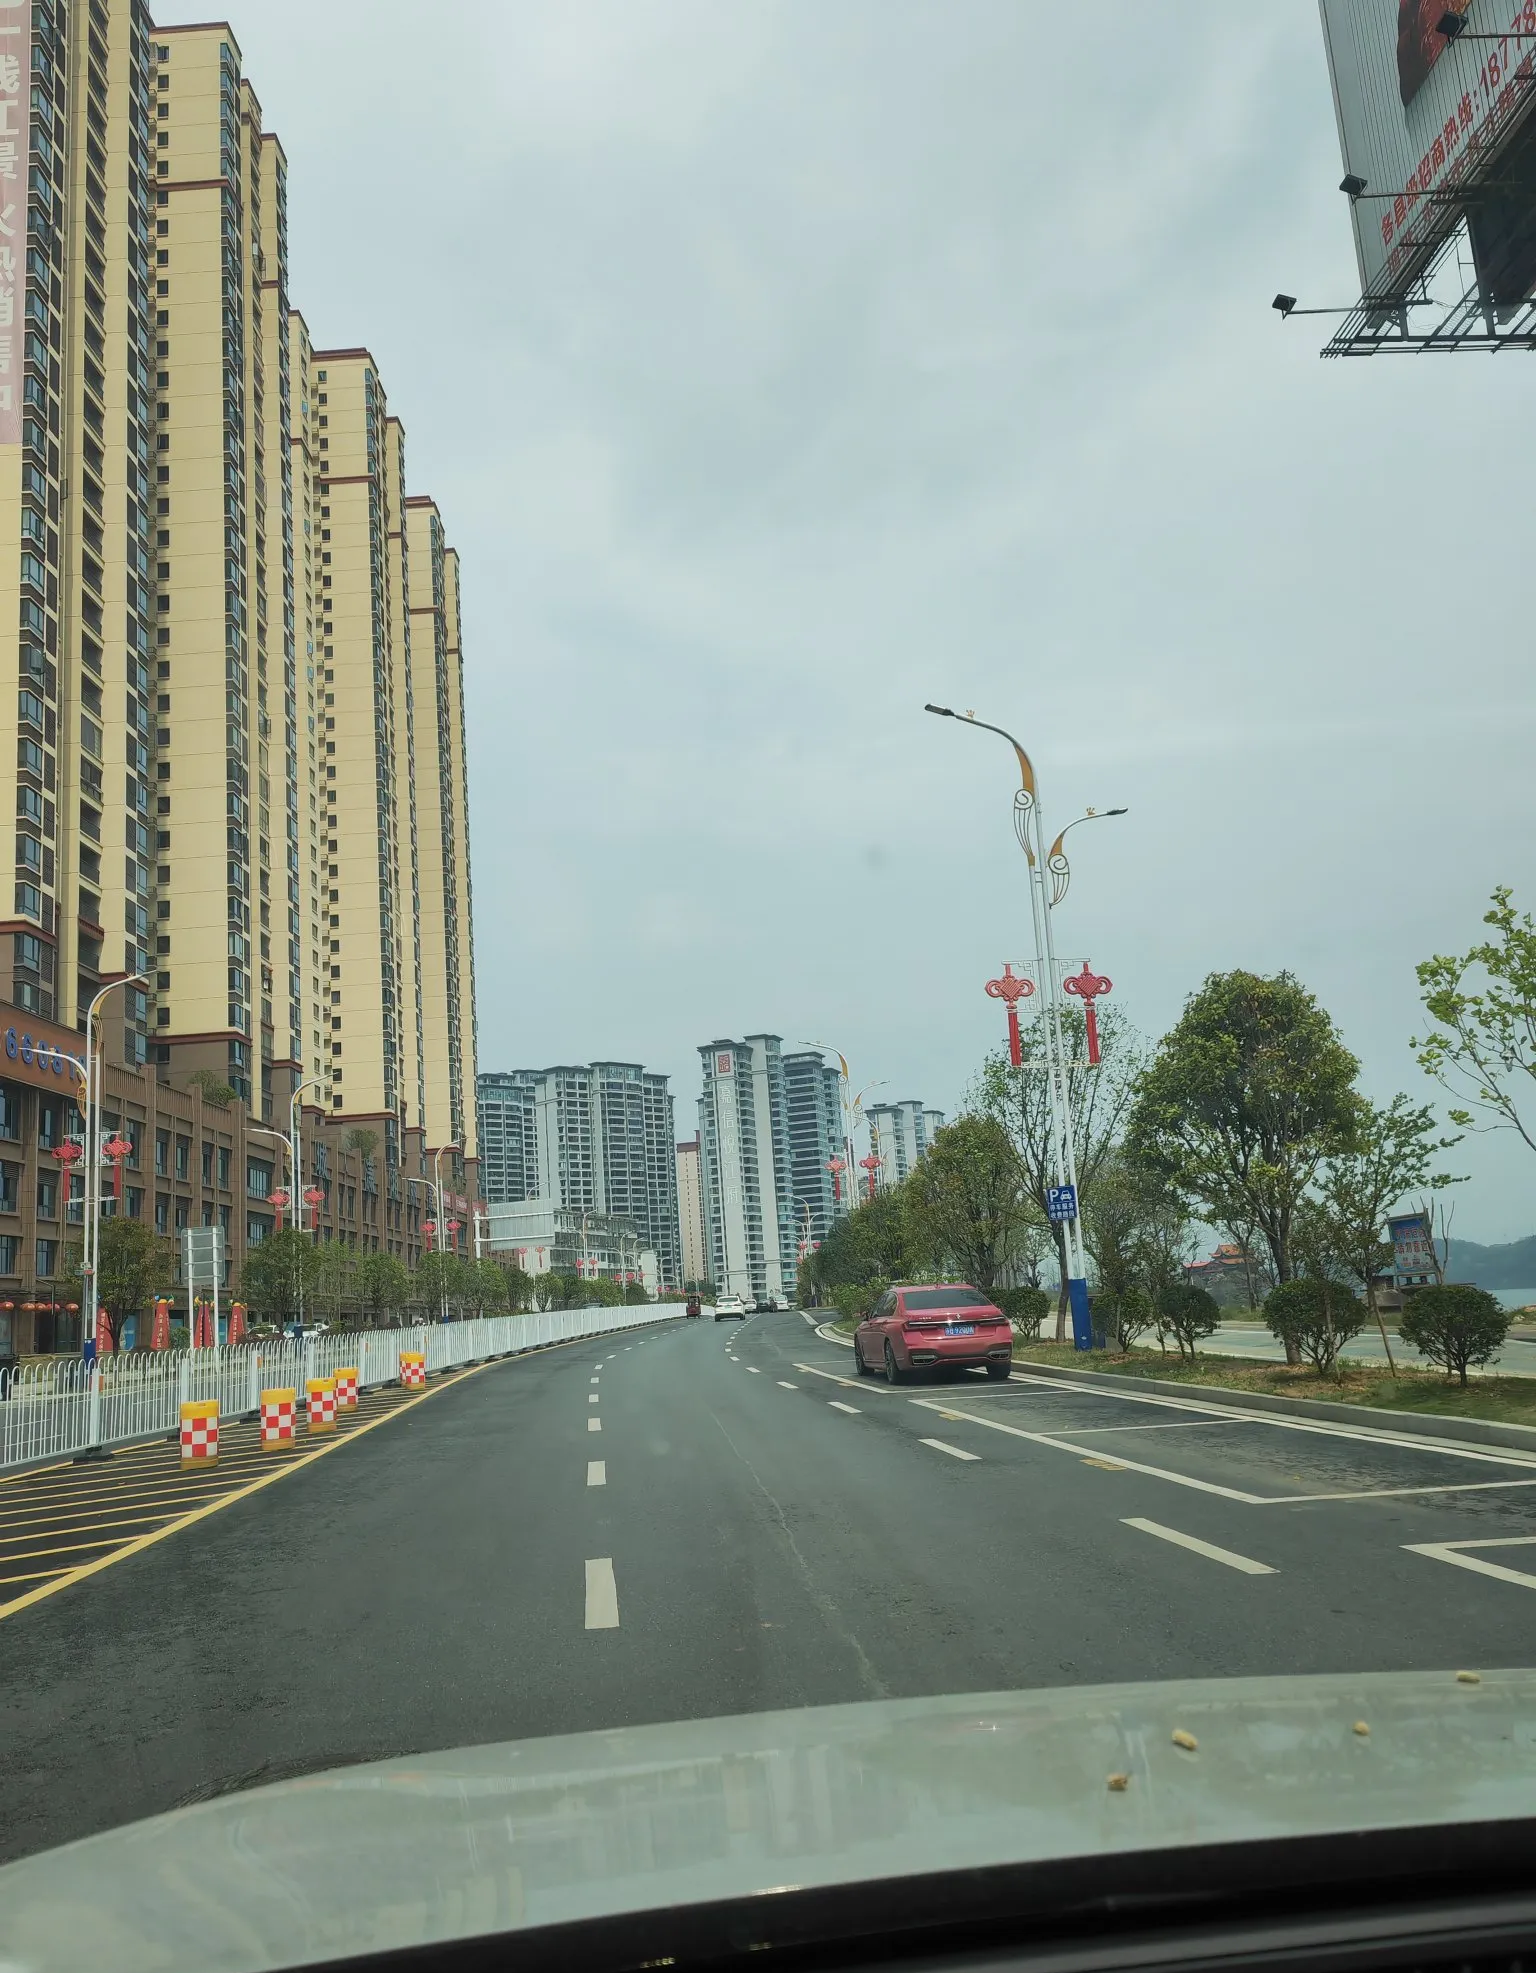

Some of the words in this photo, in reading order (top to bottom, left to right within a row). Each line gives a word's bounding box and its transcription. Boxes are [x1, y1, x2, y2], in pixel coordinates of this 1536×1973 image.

[719, 1085, 739, 1206] 嘉信悦江府
[1049, 1189, 1059, 1202] P
[1050, 1202, 1074, 1211] 停车服务
[1050, 1210, 1075, 1219] 收费路段
